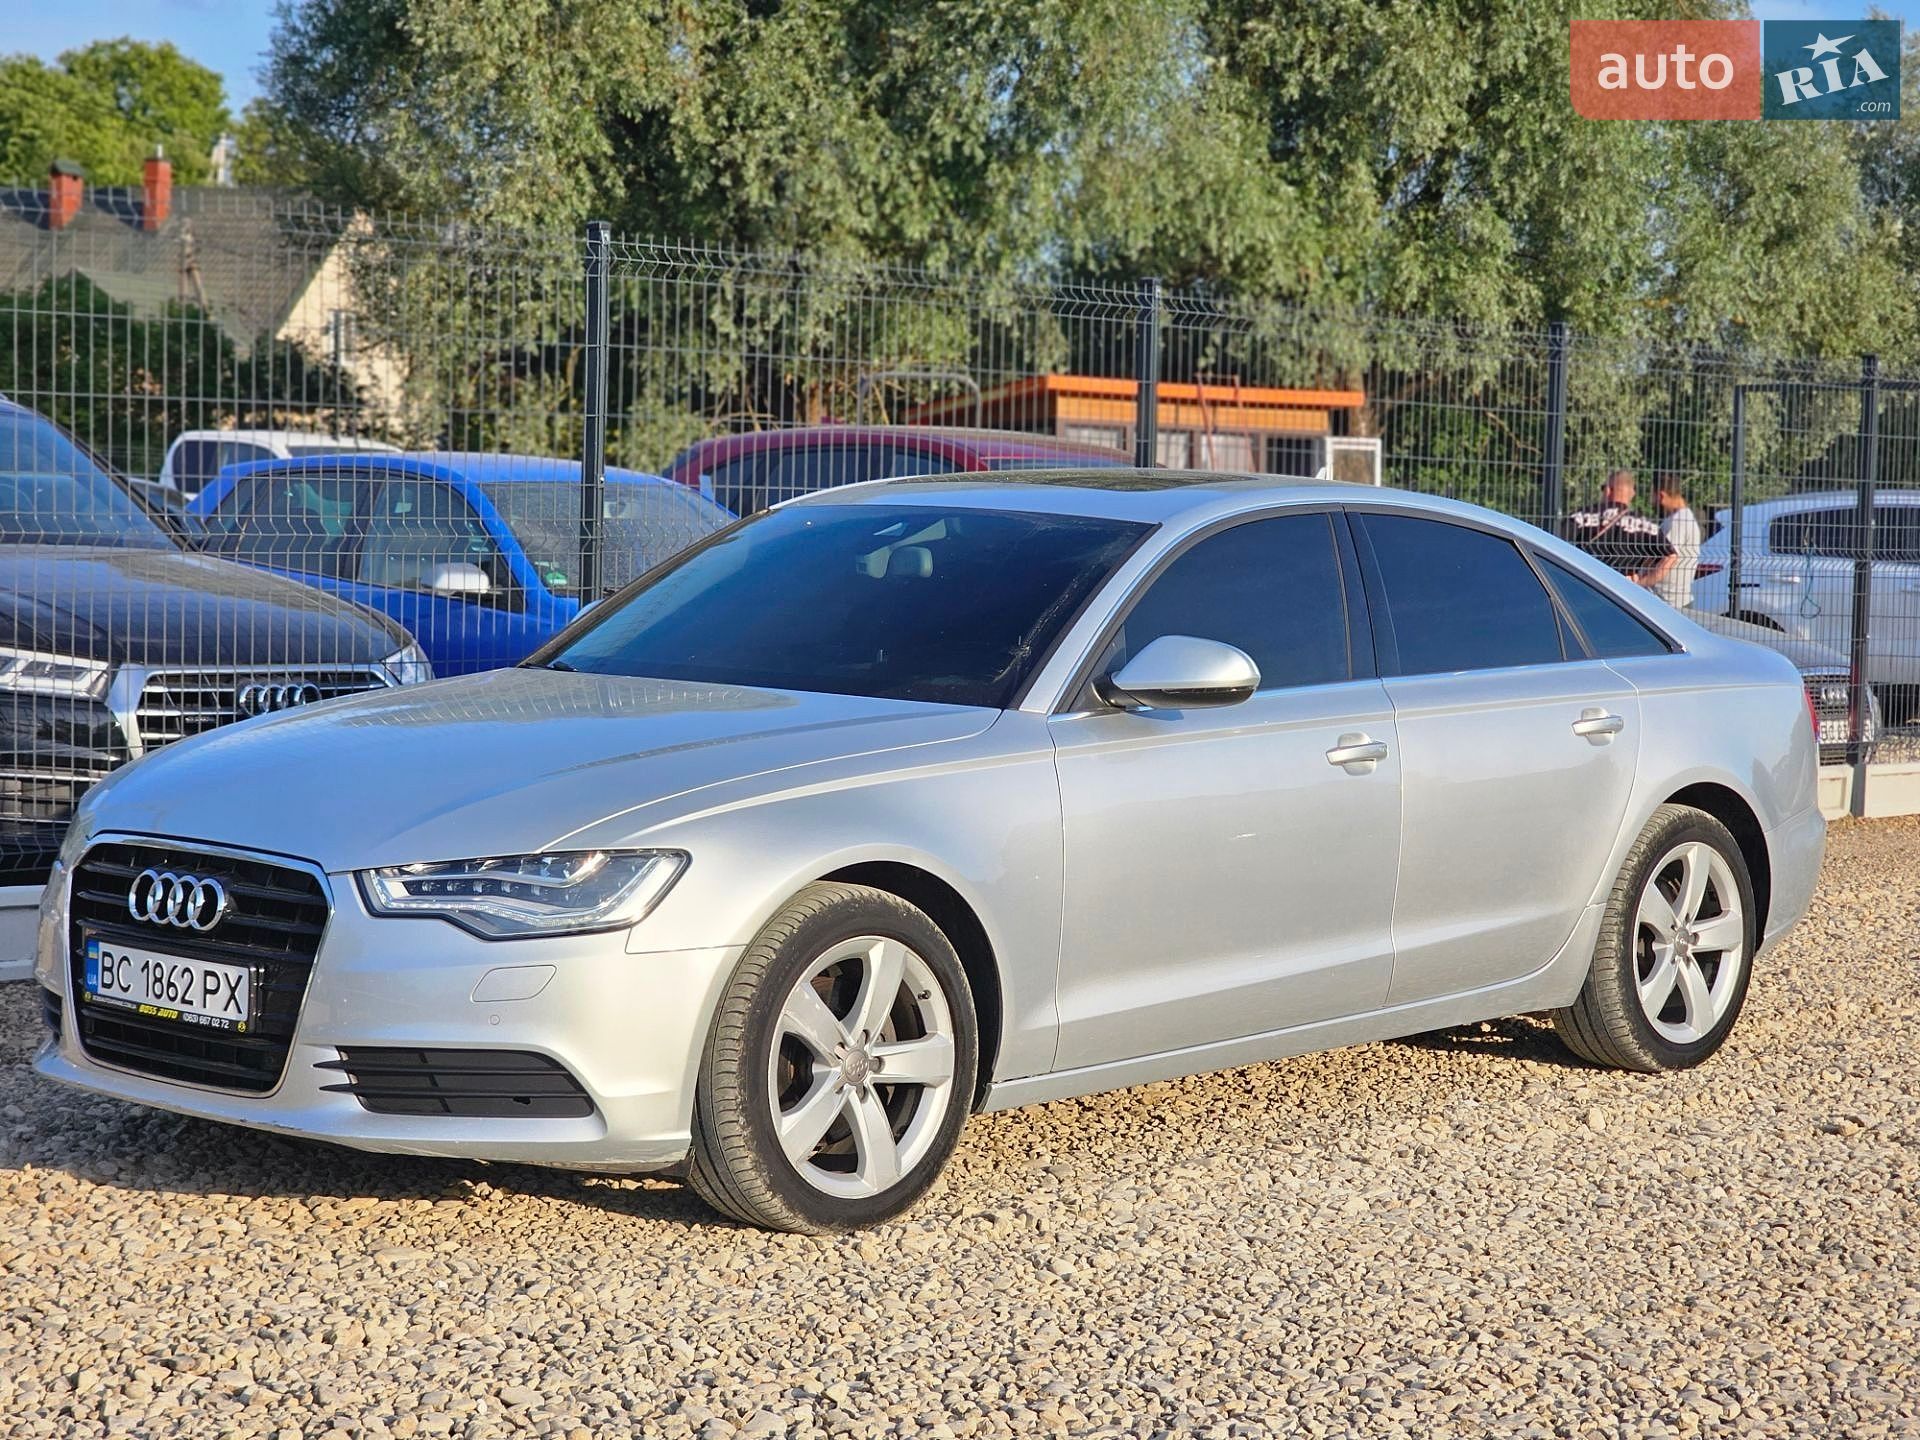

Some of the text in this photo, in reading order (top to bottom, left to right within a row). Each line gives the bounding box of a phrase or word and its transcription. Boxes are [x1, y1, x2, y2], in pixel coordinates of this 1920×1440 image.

[101, 951, 243, 1014] BC 1862 PX
